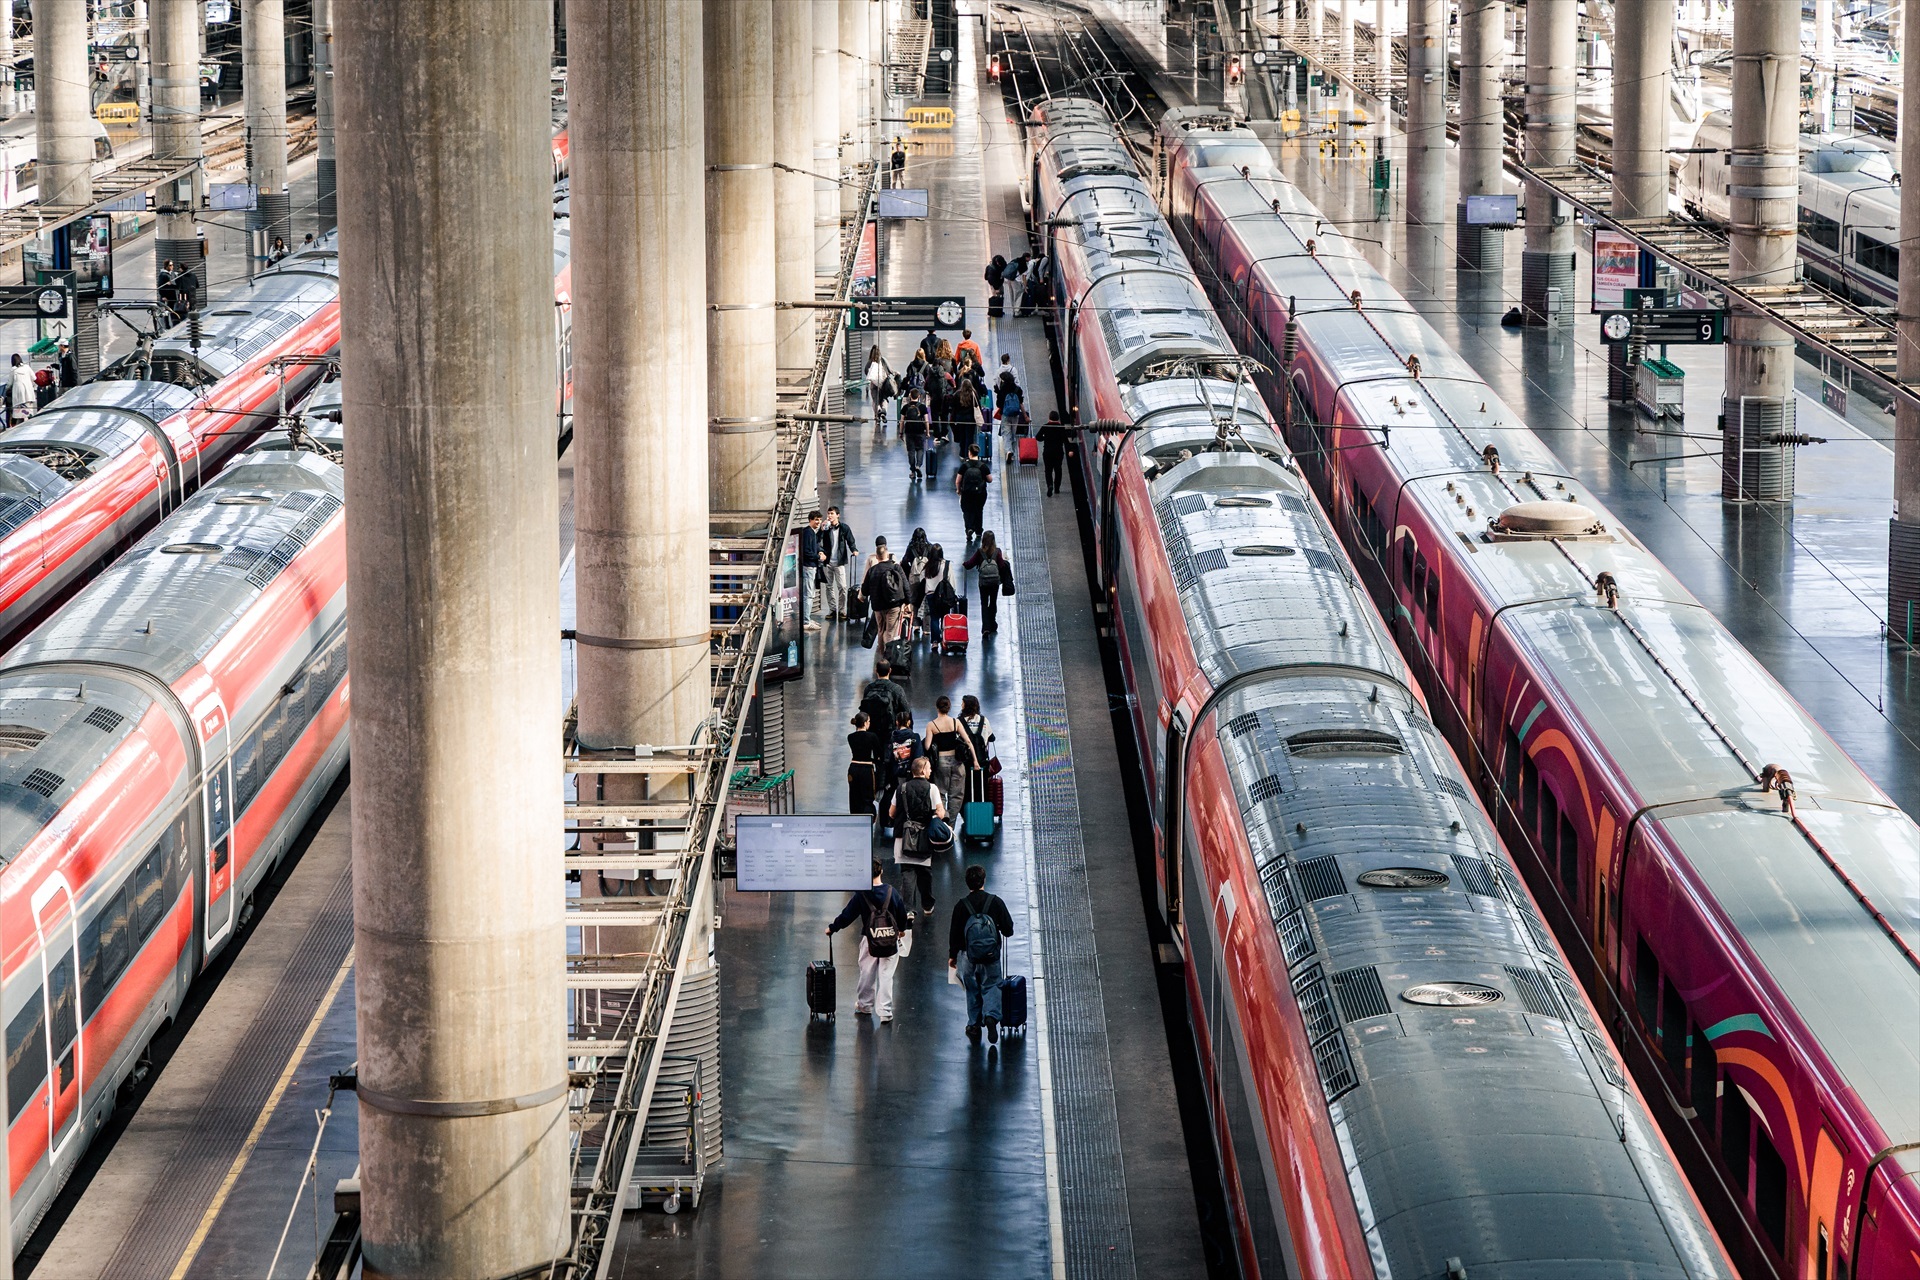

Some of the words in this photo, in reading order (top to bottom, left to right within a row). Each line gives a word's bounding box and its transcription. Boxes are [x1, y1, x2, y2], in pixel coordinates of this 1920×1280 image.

[1321, 88, 1326, 97] 9
[859, 311, 869, 327] 8
[1701, 324, 1712, 340] 9
[869, 926, 896, 939] VANS
